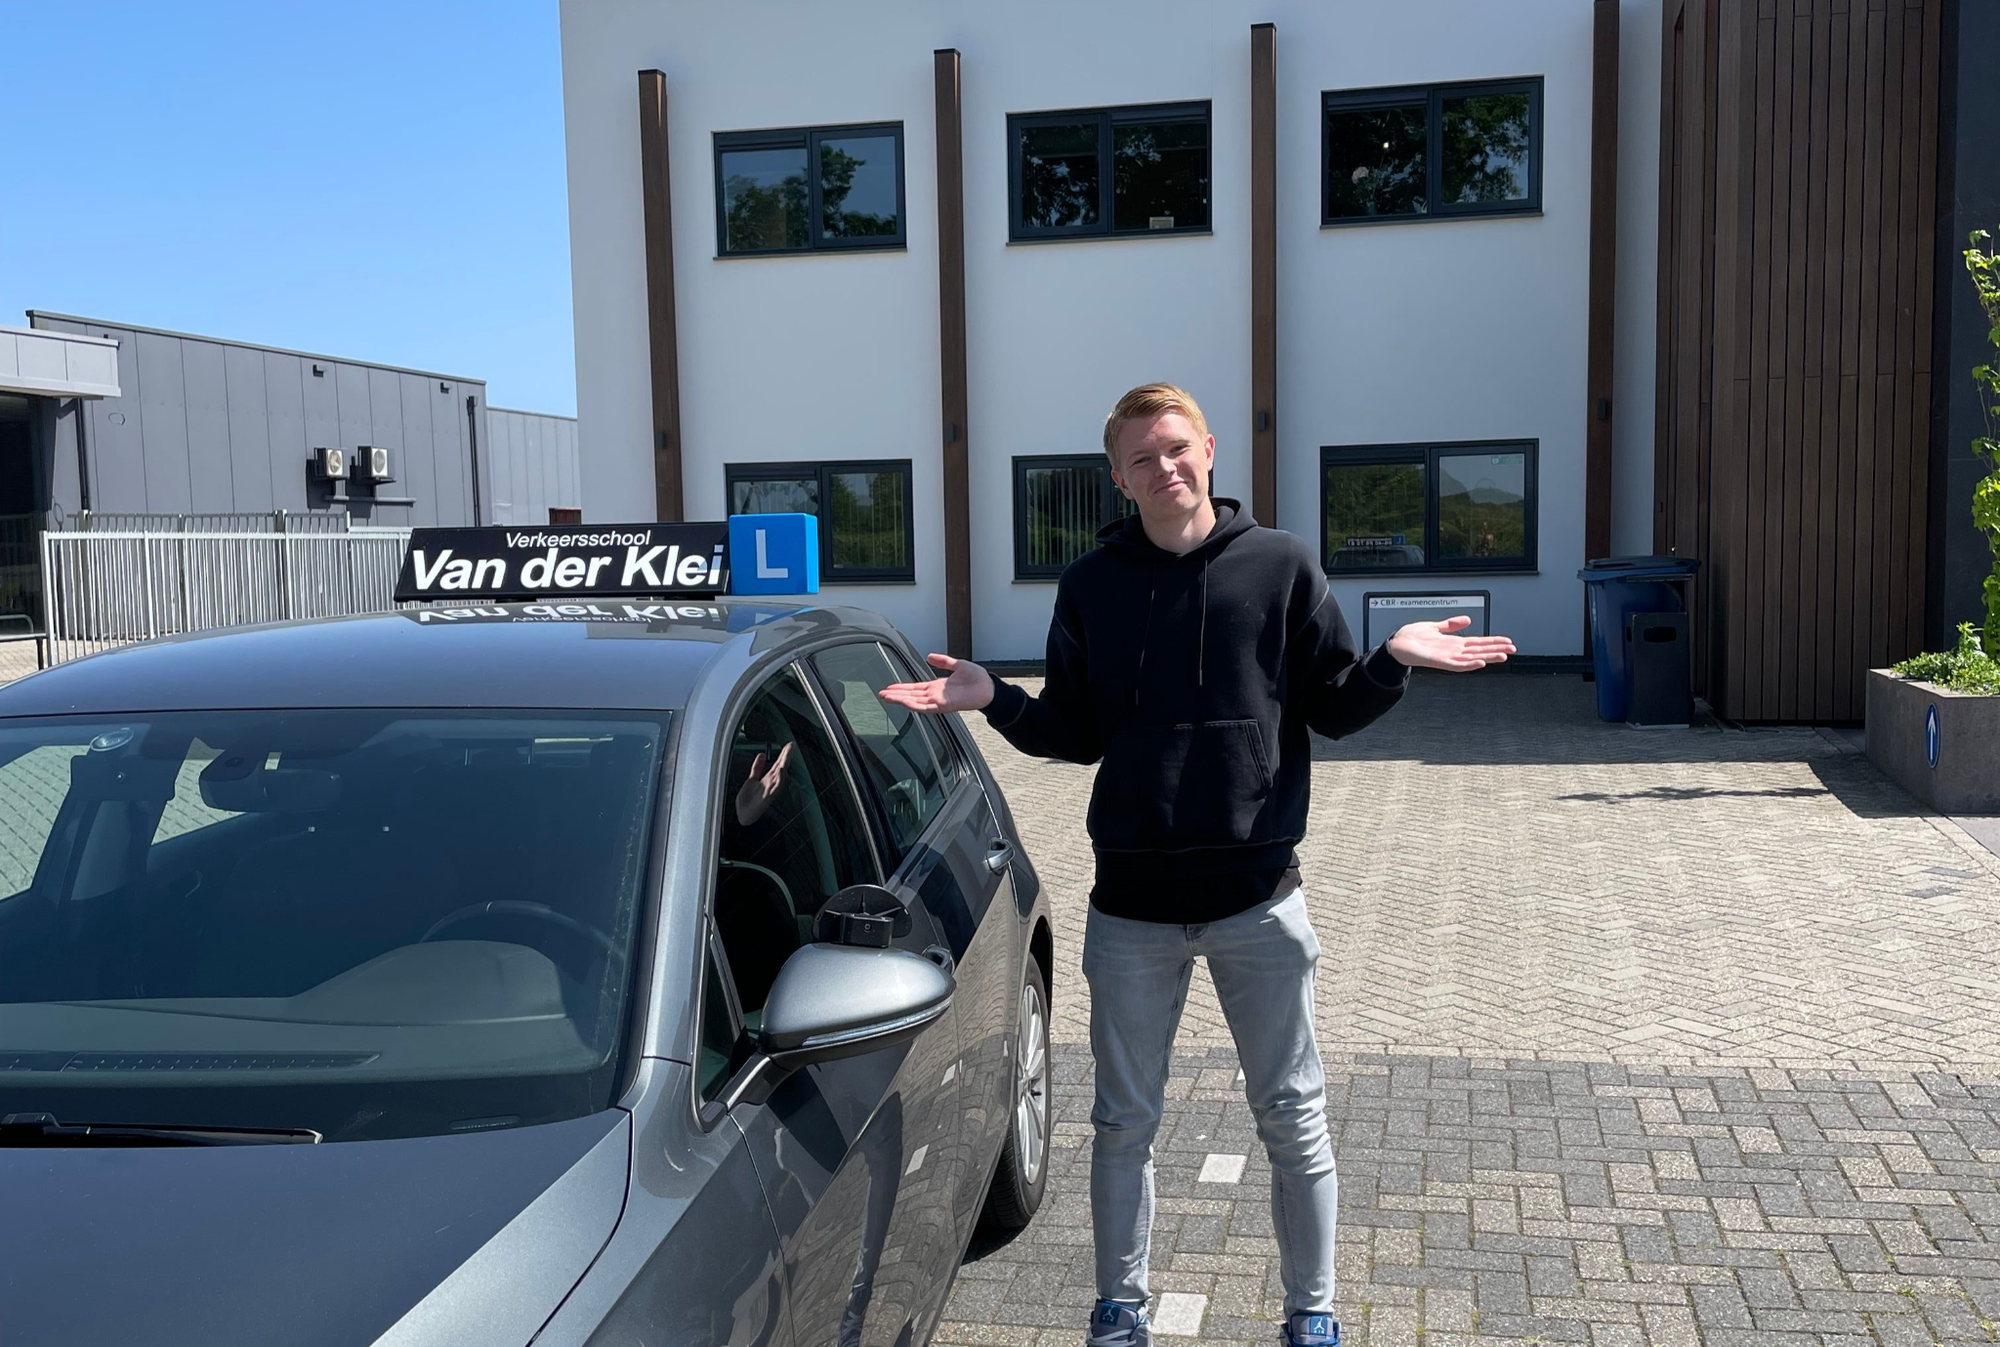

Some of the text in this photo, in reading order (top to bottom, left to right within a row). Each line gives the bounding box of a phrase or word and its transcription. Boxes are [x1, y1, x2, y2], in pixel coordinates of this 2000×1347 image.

[506, 530, 651, 548] Verkeersschool
[755, 529, 789, 579] L
[413, 544, 724, 590] Van der Klei
